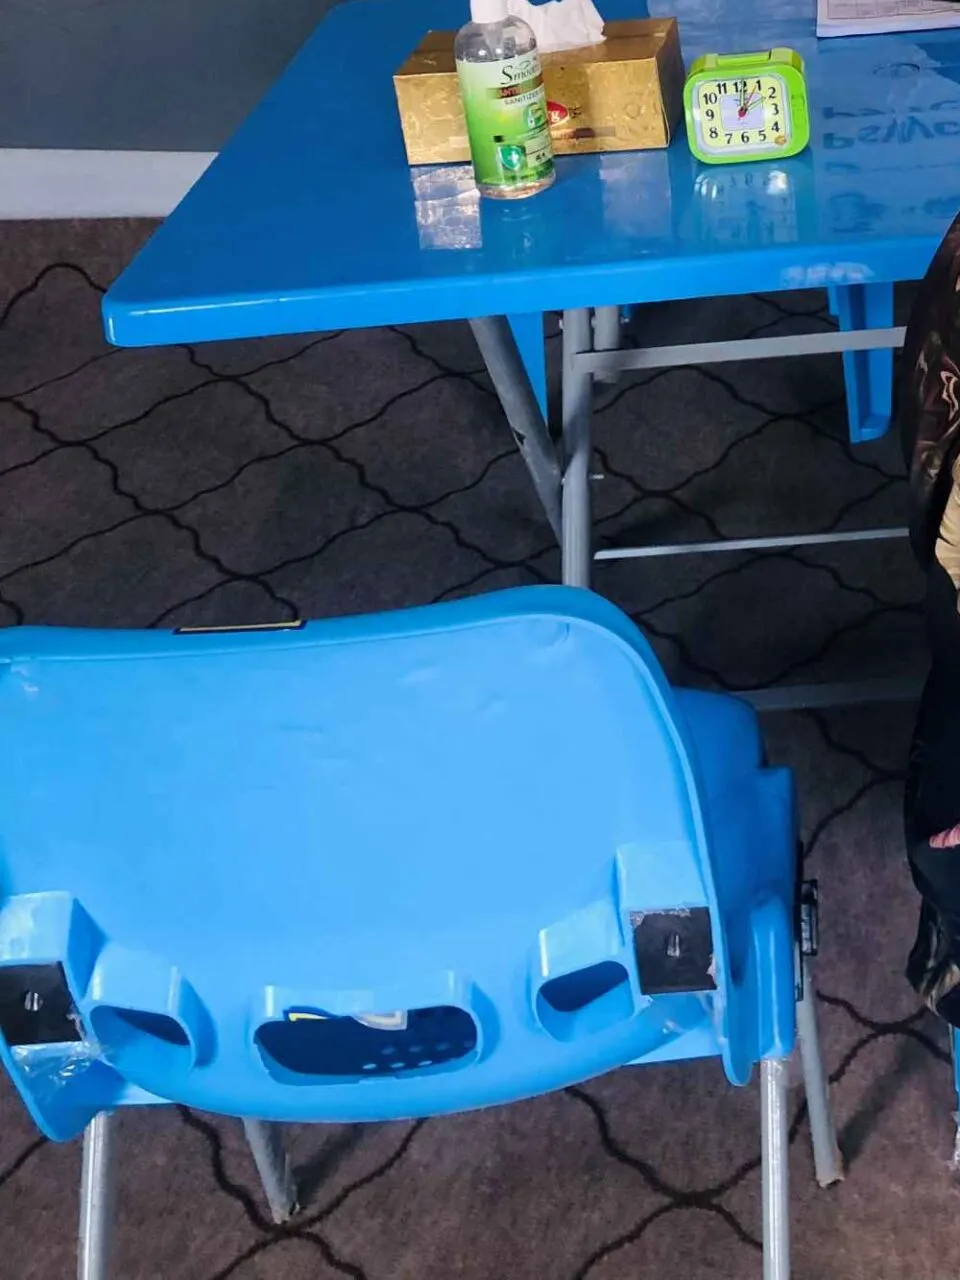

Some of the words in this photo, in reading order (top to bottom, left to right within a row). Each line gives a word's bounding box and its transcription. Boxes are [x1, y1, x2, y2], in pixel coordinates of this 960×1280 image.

[716, 82, 727, 94] 11
[756, 80, 762, 91] 1
[768, 86, 777, 99] 2
[703, 93, 718, 105] 10
[706, 109, 714, 121] 9
[771, 103, 779, 115] 3
[771, 121, 780, 132] 4
[709, 127, 718, 139] 8
[725, 133, 733, 144] 7
[741, 131, 750, 144] 6
[758, 130, 767, 141] 5
